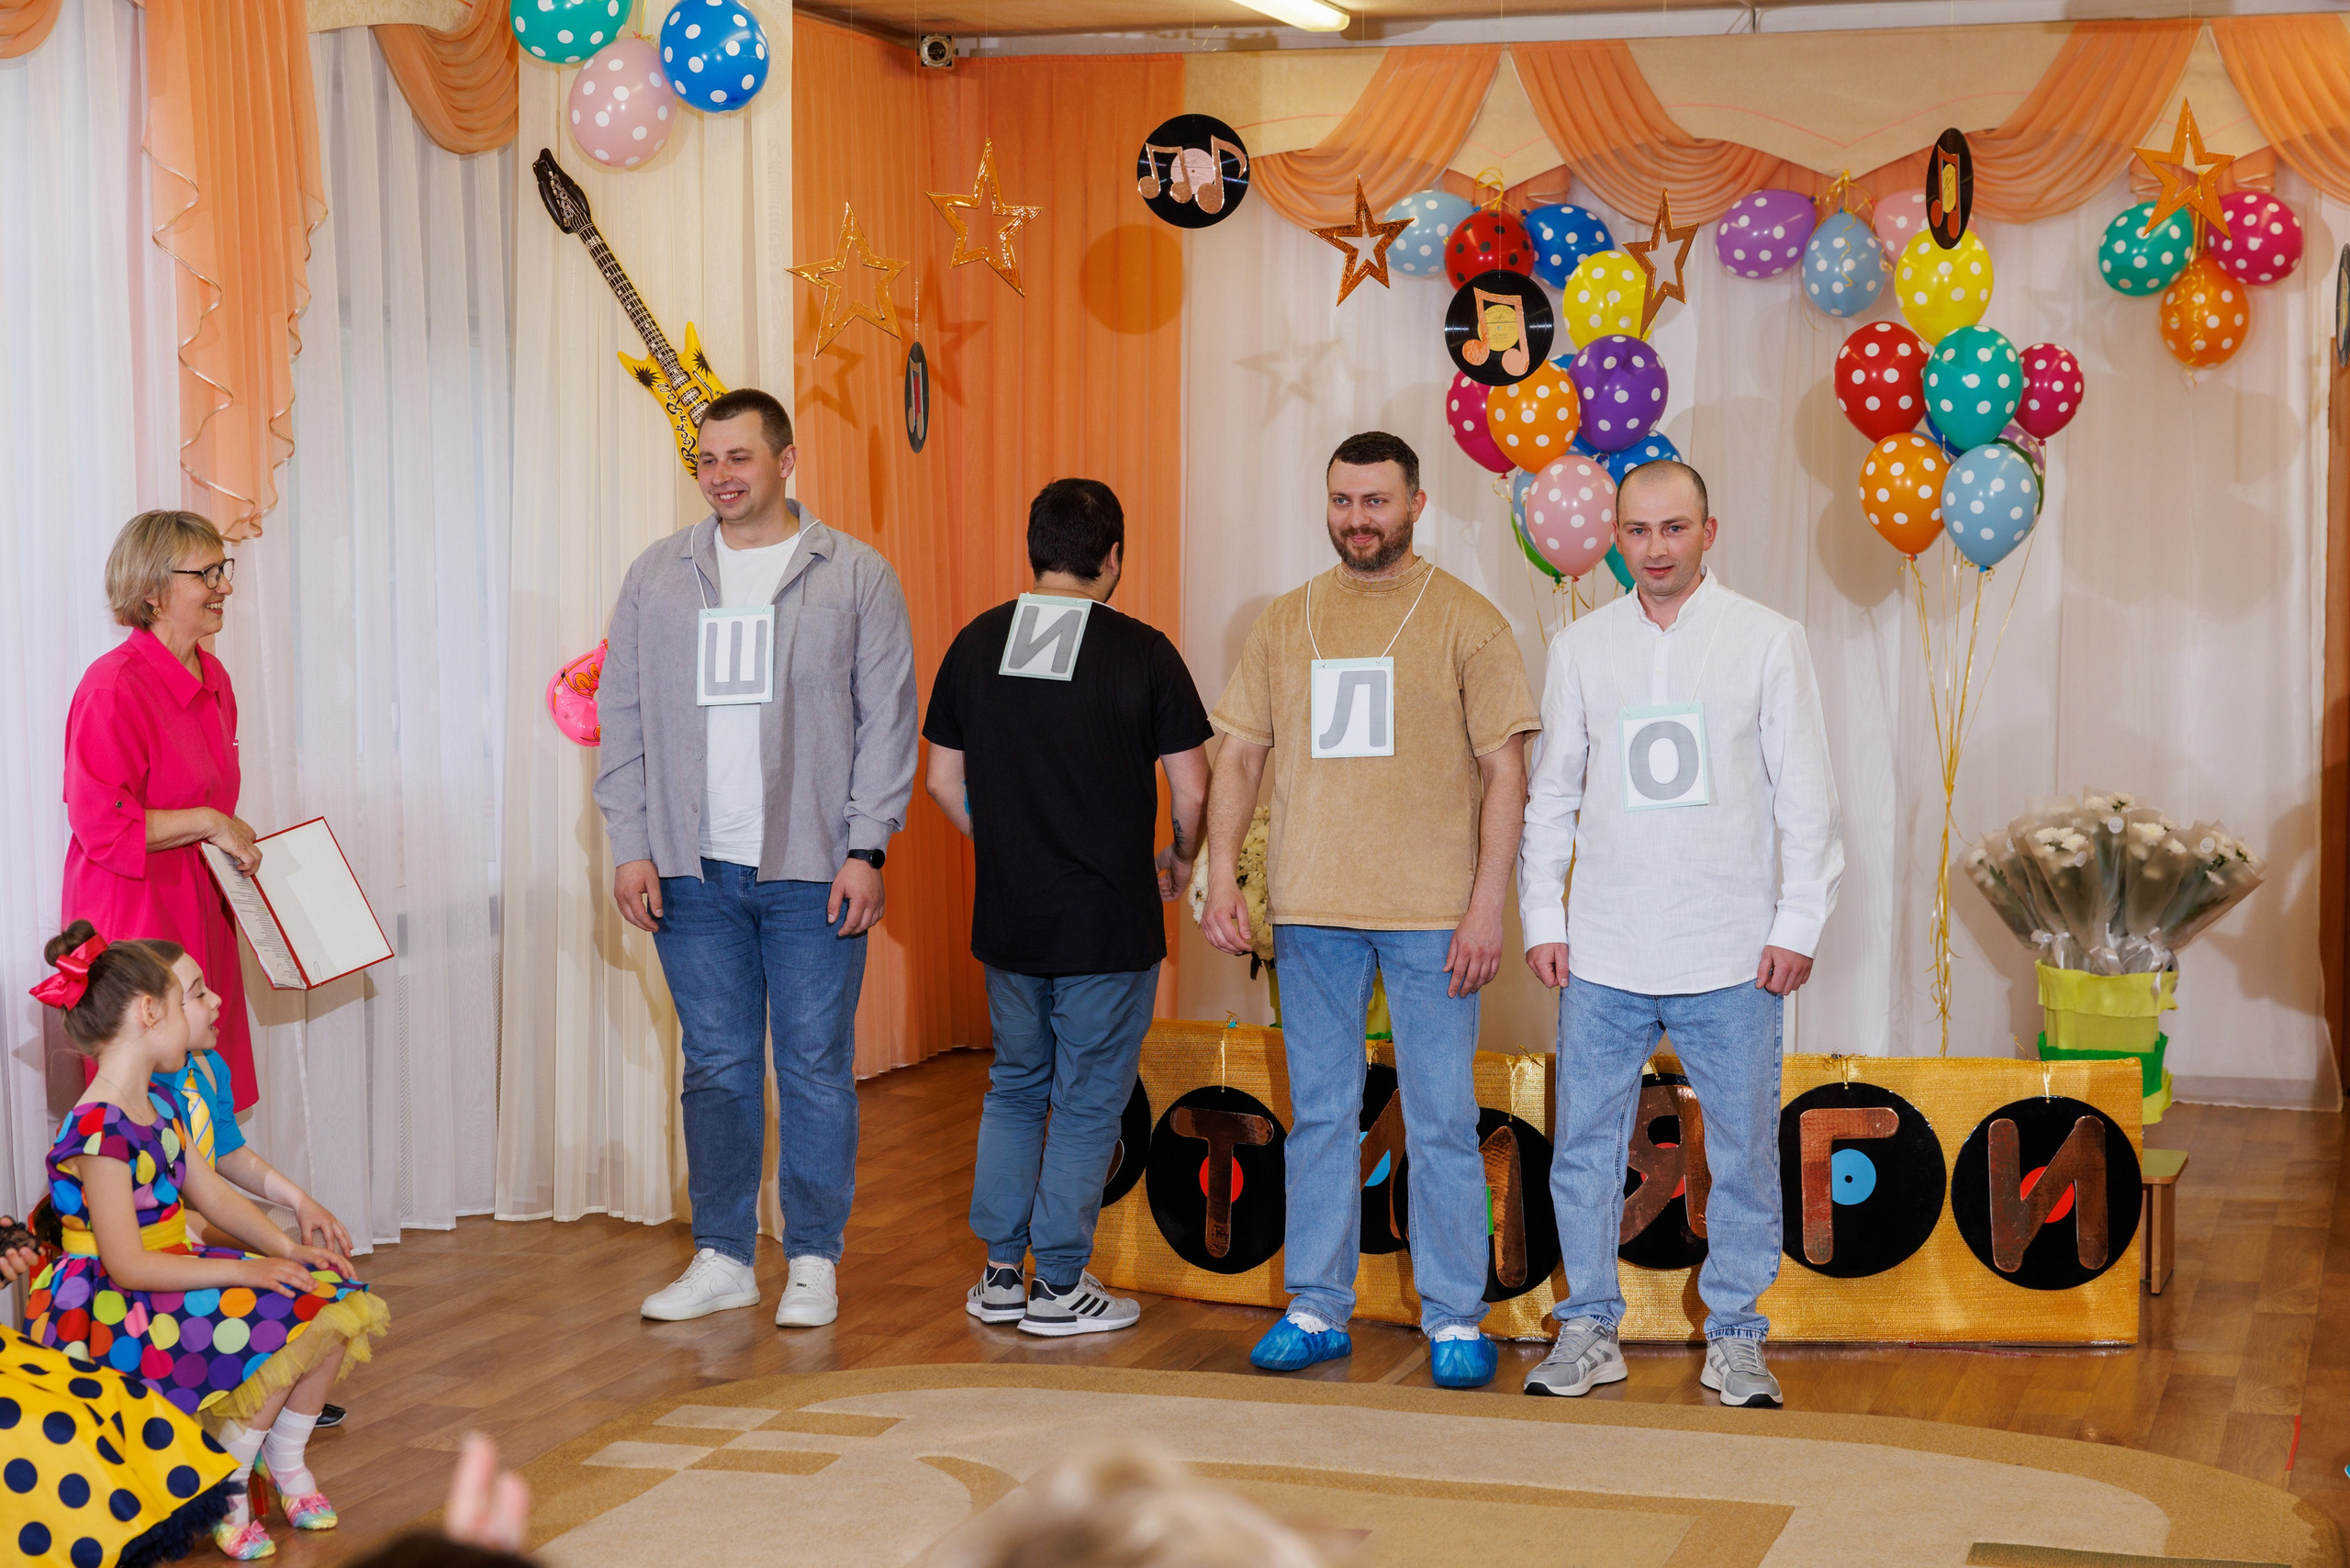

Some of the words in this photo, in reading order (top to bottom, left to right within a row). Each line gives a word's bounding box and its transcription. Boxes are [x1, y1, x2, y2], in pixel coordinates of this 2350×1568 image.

[704, 620, 767, 696] Ш
[1008, 605, 1082, 674] И
[1319, 670, 1386, 749] Л
[1629, 722, 1699, 800] О
[1104, 1085, 2108, 1288] ТЛЯГИ
